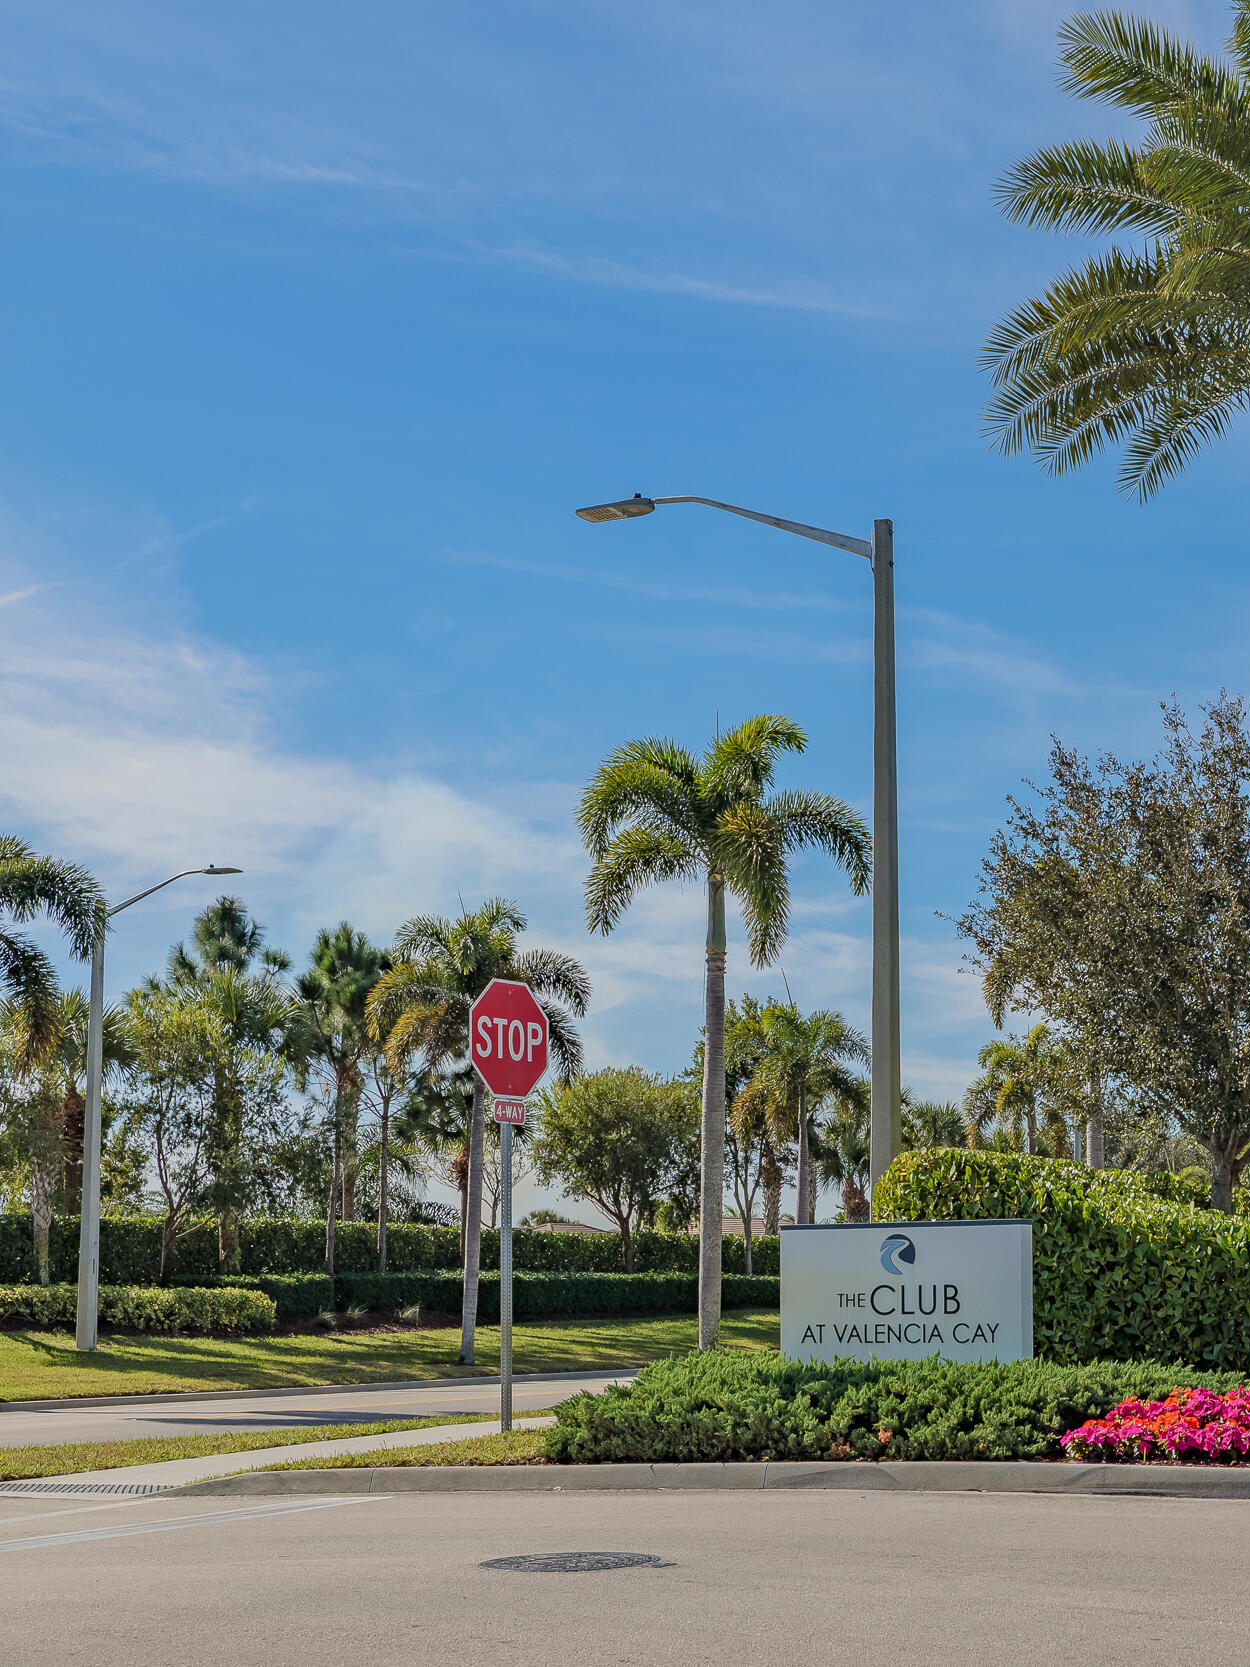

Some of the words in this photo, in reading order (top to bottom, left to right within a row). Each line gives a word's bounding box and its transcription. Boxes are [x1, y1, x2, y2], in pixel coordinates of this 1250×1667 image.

[475, 1015, 543, 1062] STOP
[496, 1104, 523, 1120] 4-WAY
[837, 1292, 866, 1308] THE
[870, 1284, 961, 1316] CLUB
[801, 1324, 826, 1344] AT
[833, 1322, 944, 1344] VALENCIA
[952, 1322, 1000, 1344] CAY
